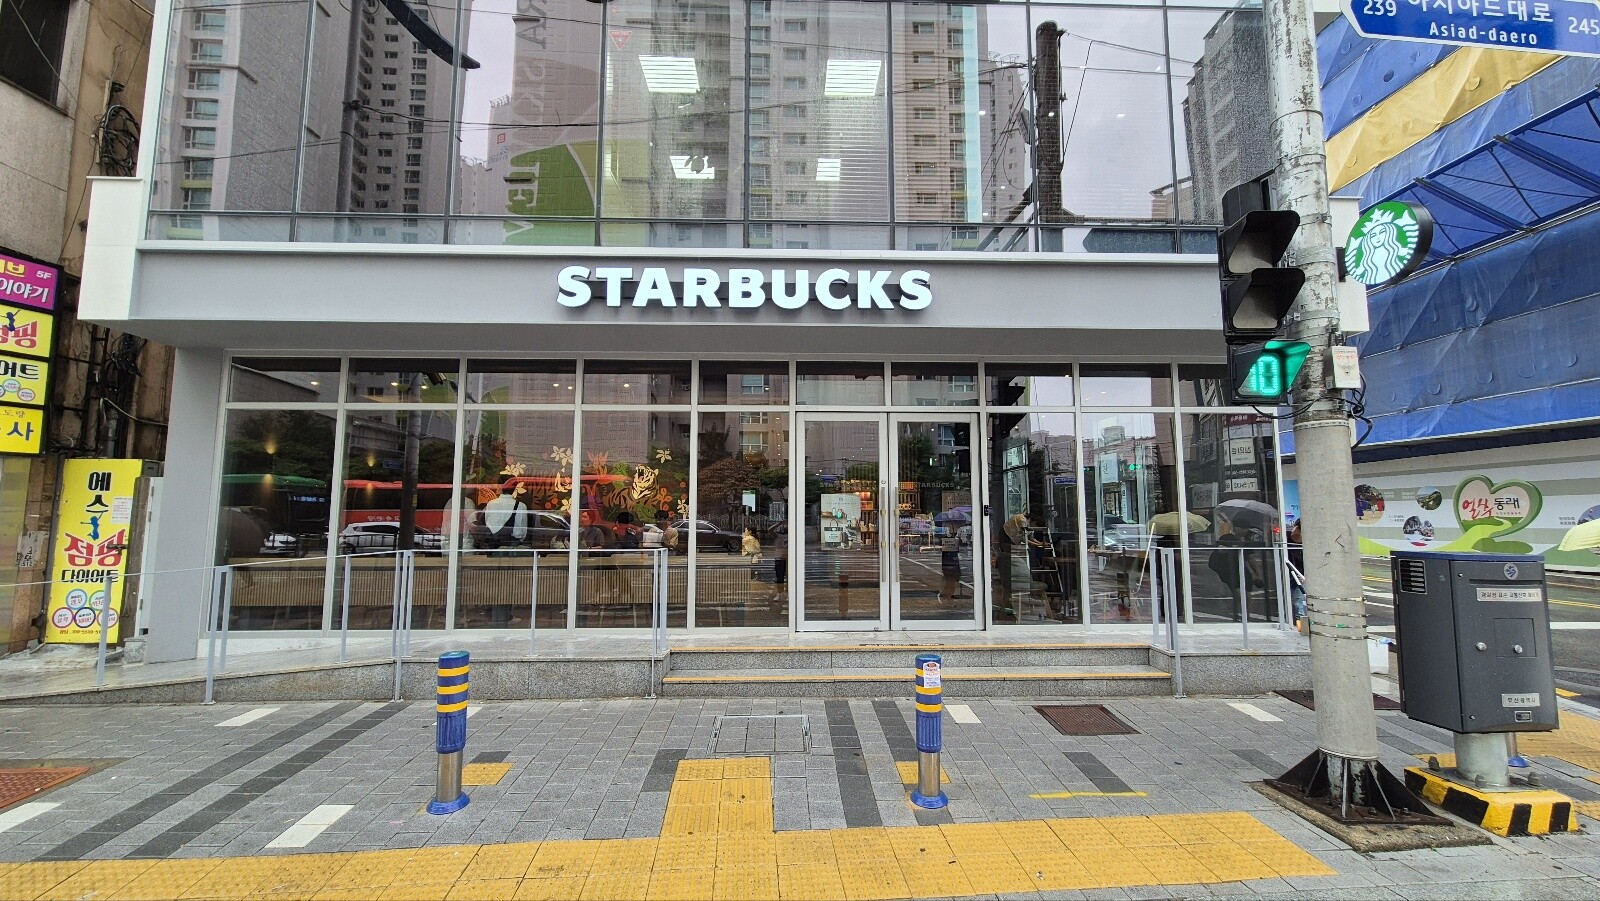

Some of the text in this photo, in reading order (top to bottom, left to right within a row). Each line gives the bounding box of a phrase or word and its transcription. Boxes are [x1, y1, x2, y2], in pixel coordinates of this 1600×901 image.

[1363, 0, 1397, 16] 239
[1429, 22, 1537, 44] Asiad-daero
[1567, 16, 1600, 36] 245
[0, 259, 26, 278] 브
[36, 270, 53, 280] 5F
[556, 265, 933, 310] STARBUCKS
[1249, 356, 1279, 394] 10
[86, 471, 112, 513] 에스
[1494, 497, 1520, 511] 동래
[64, 528, 126, 566] 점핑
[61, 569, 119, 583] 다이어트
